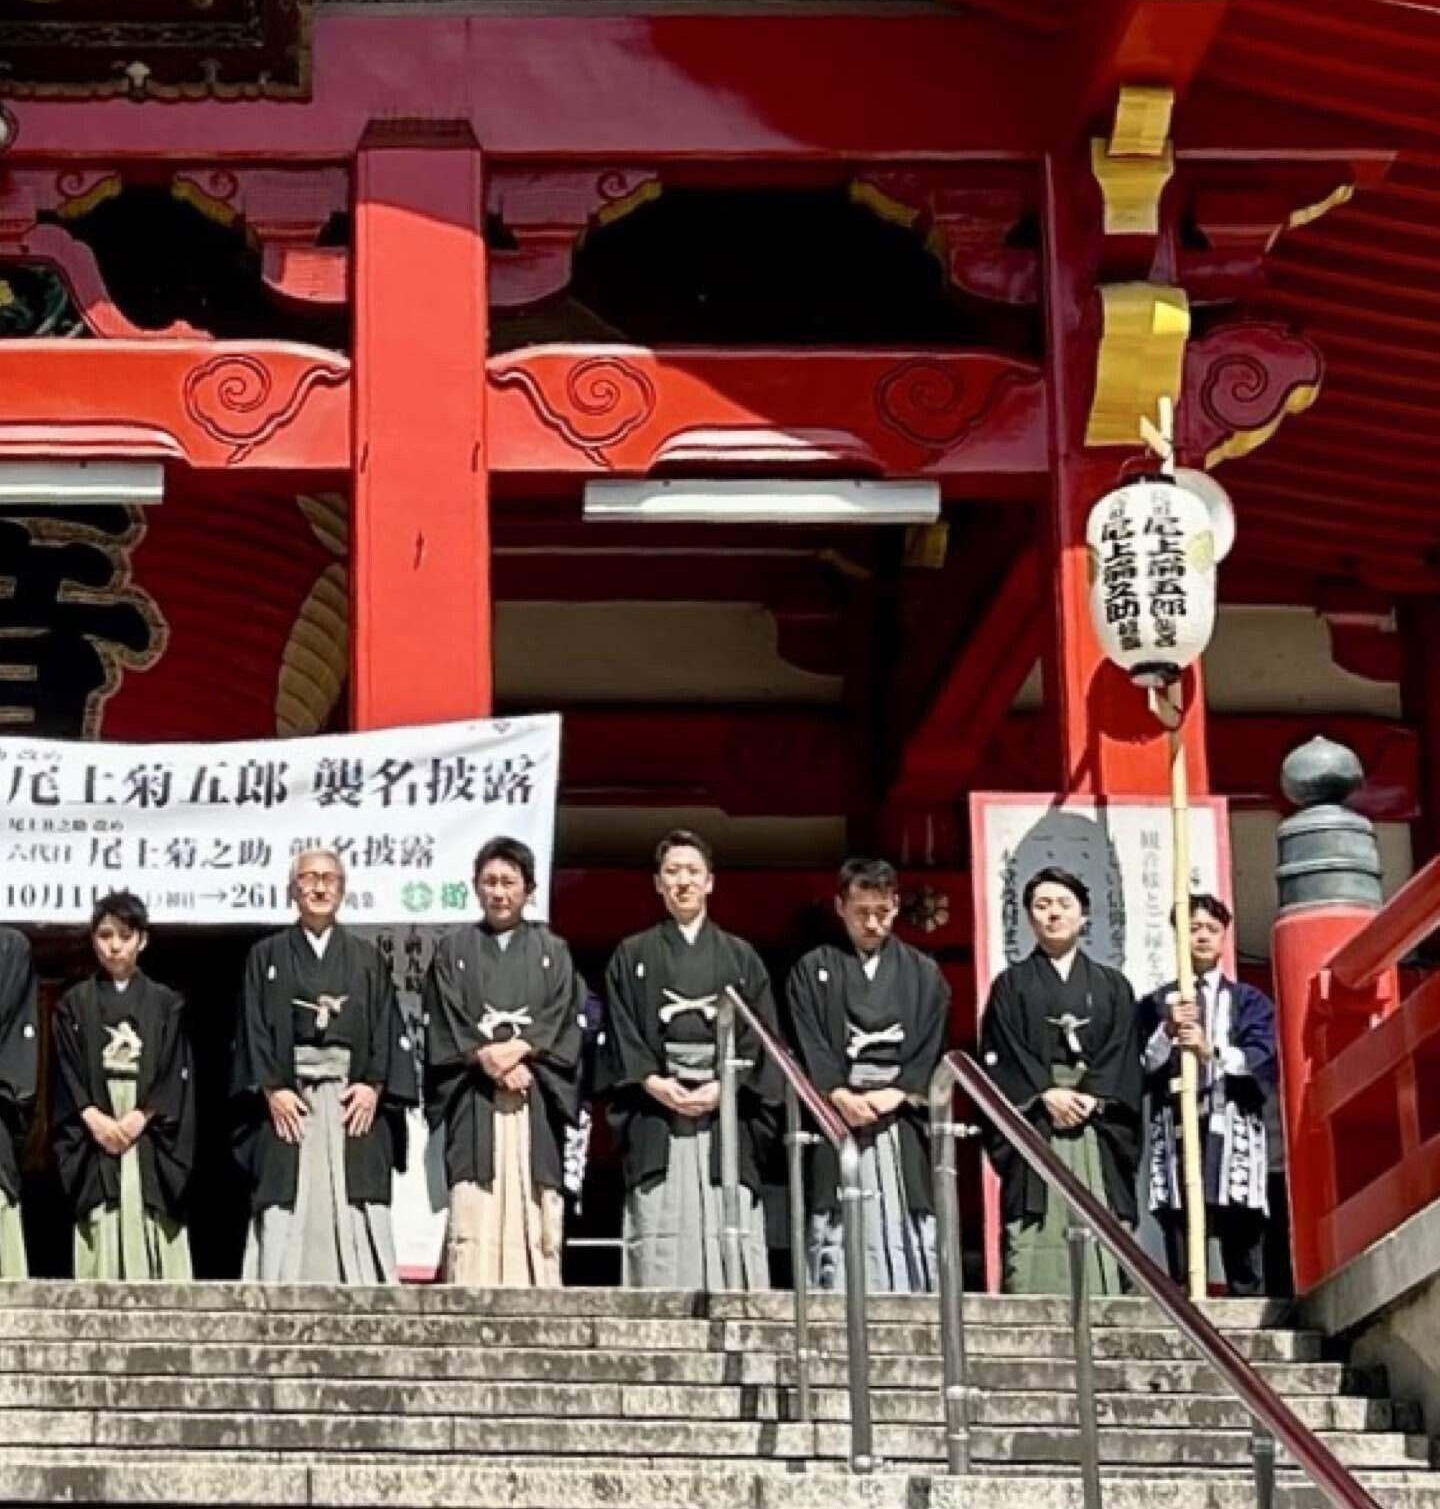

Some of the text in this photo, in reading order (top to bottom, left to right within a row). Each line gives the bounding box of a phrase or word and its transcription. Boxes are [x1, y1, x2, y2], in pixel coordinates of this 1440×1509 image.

[6, 758, 290, 809] 尾上菊五郎
[312, 754, 538, 809] 襲名披露
[6, 842, 72, 864] 六代目
[88, 836, 272, 870] 尾上菊之助
